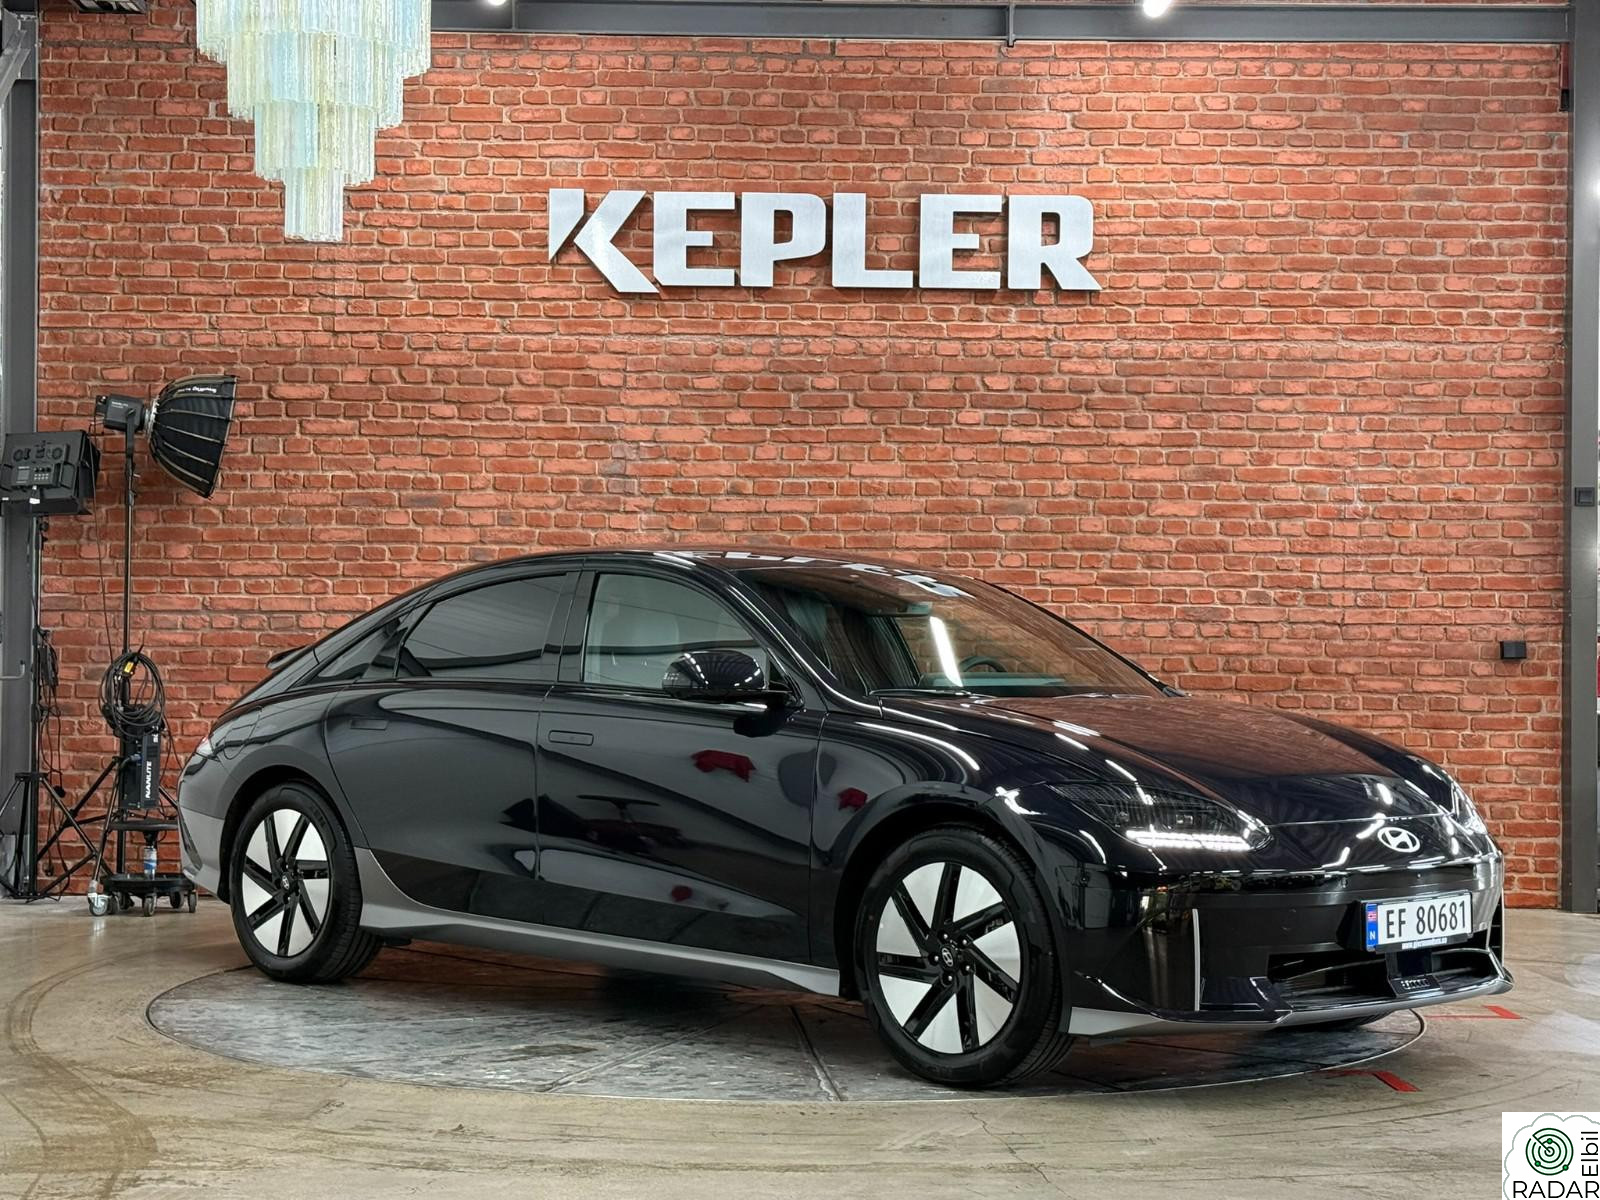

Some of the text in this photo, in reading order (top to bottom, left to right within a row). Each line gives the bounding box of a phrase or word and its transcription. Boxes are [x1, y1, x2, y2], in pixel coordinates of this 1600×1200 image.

[549, 188, 1102, 293] KEPLER
[1370, 931, 1376, 940] N
[1386, 900, 1466, 938] EF 80681
